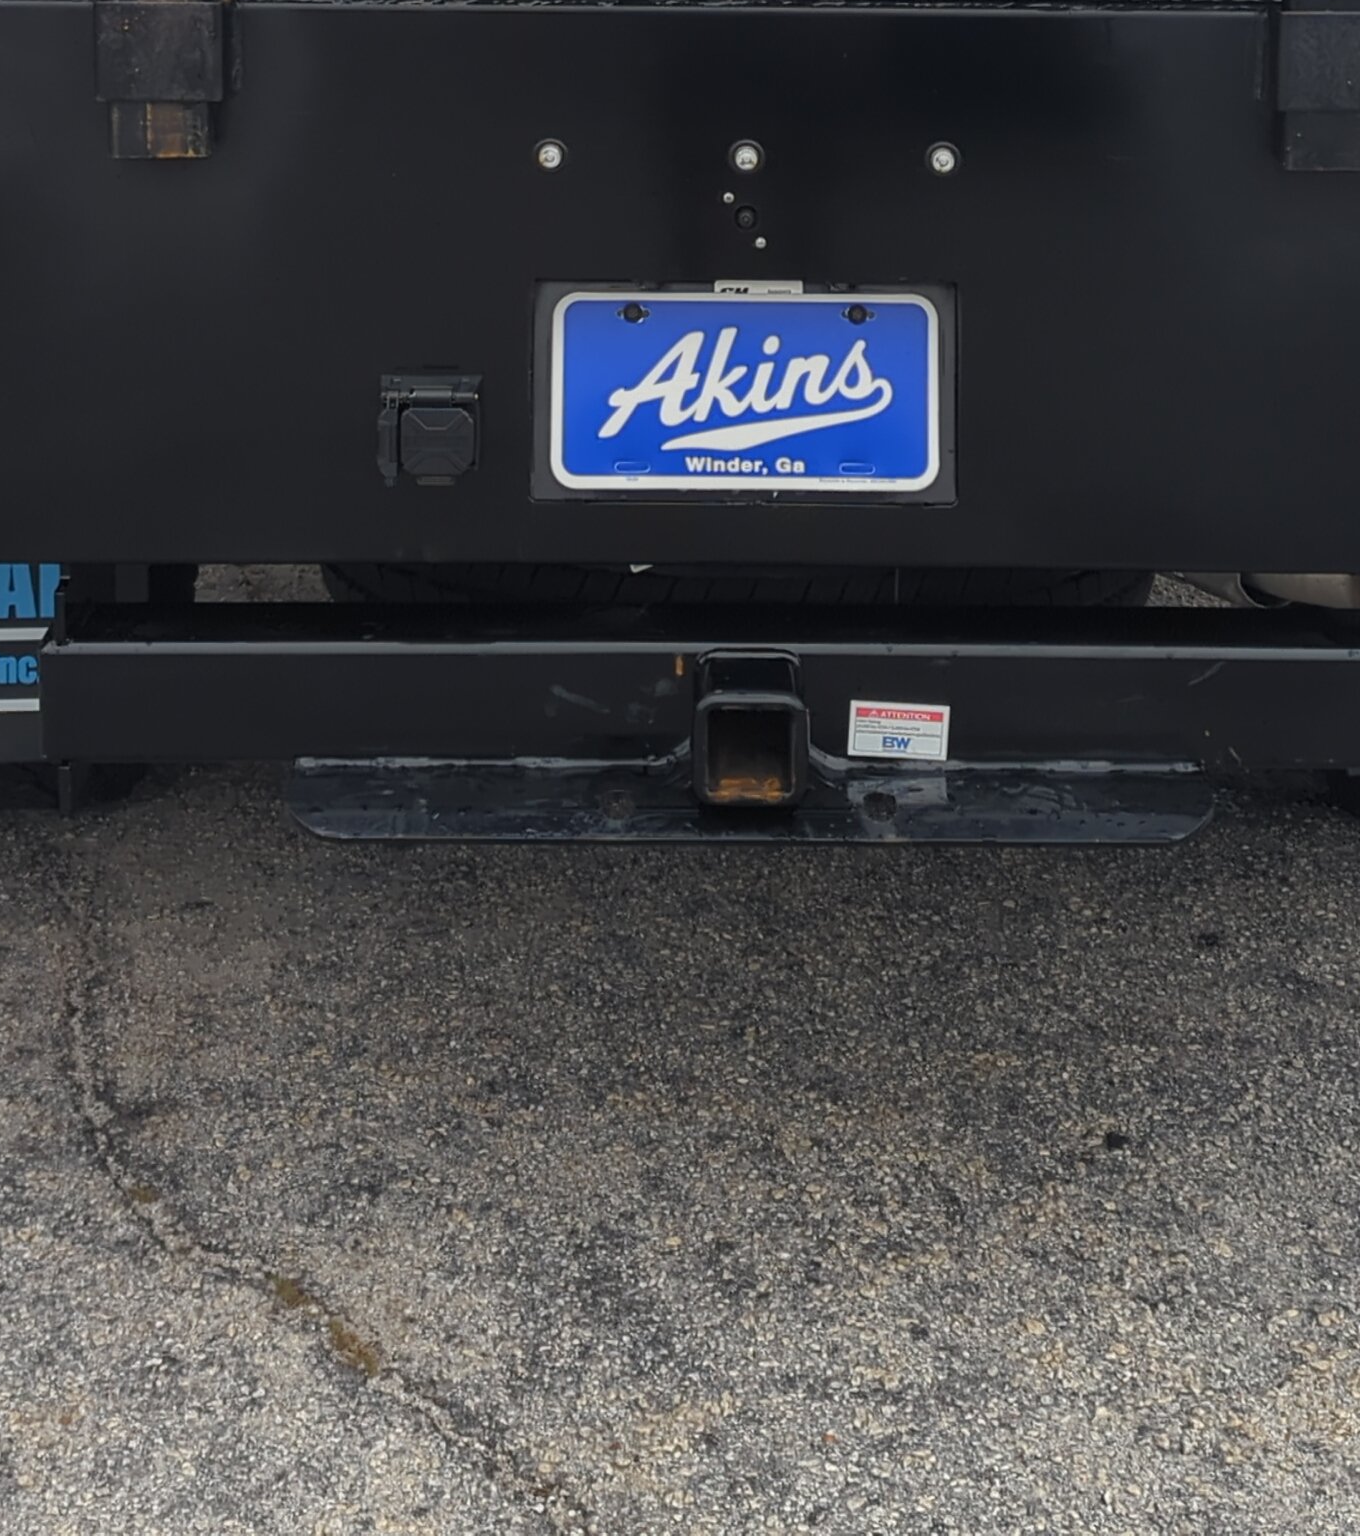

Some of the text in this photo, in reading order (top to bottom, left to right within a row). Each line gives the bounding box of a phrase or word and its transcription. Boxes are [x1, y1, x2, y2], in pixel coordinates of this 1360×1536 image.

[597, 326, 893, 451] Akins
[685, 456, 806, 475] Winder, Ga
[880, 711, 931, 721] ATTENTION
